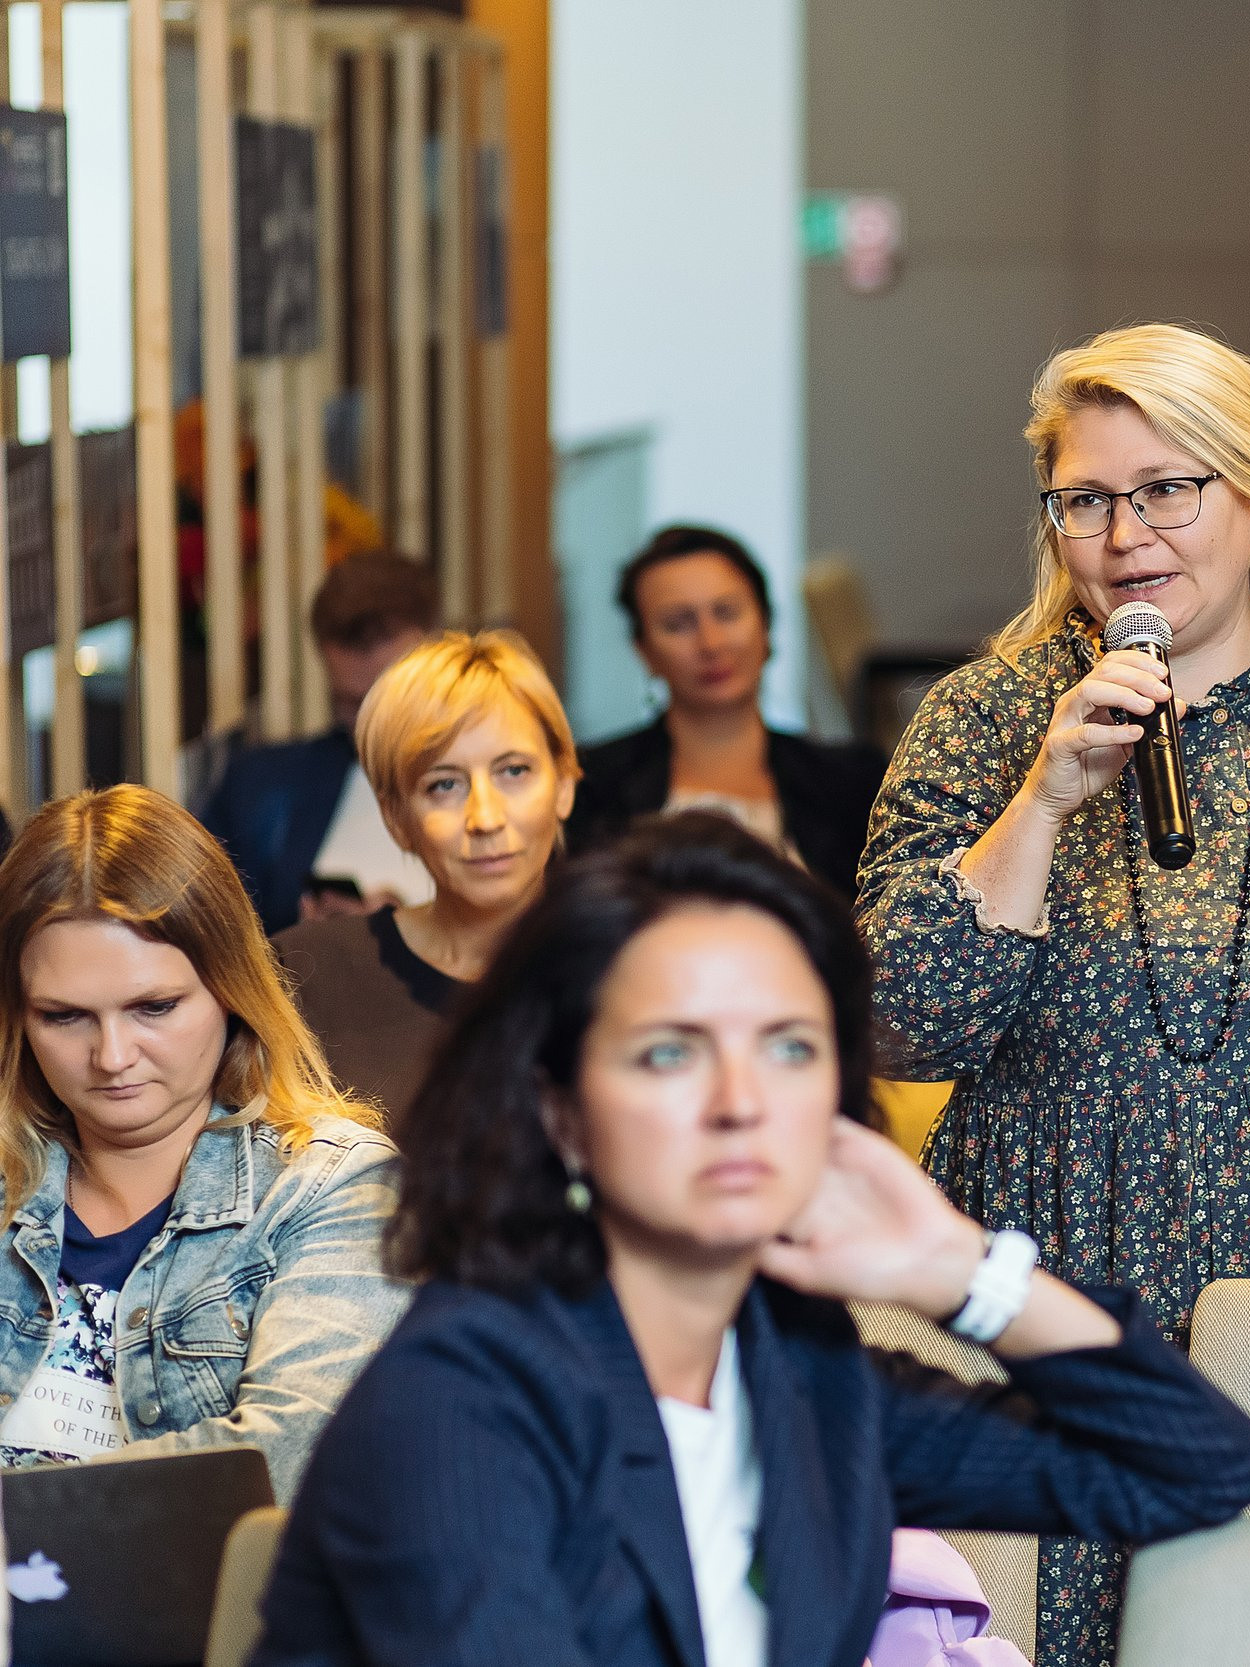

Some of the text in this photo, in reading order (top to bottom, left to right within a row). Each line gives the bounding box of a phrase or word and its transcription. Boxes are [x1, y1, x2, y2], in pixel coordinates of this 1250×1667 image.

[78, 1397, 94, 1414] IS
[53, 1419, 77, 1436] OF
[83, 1427, 118, 1449] THE
